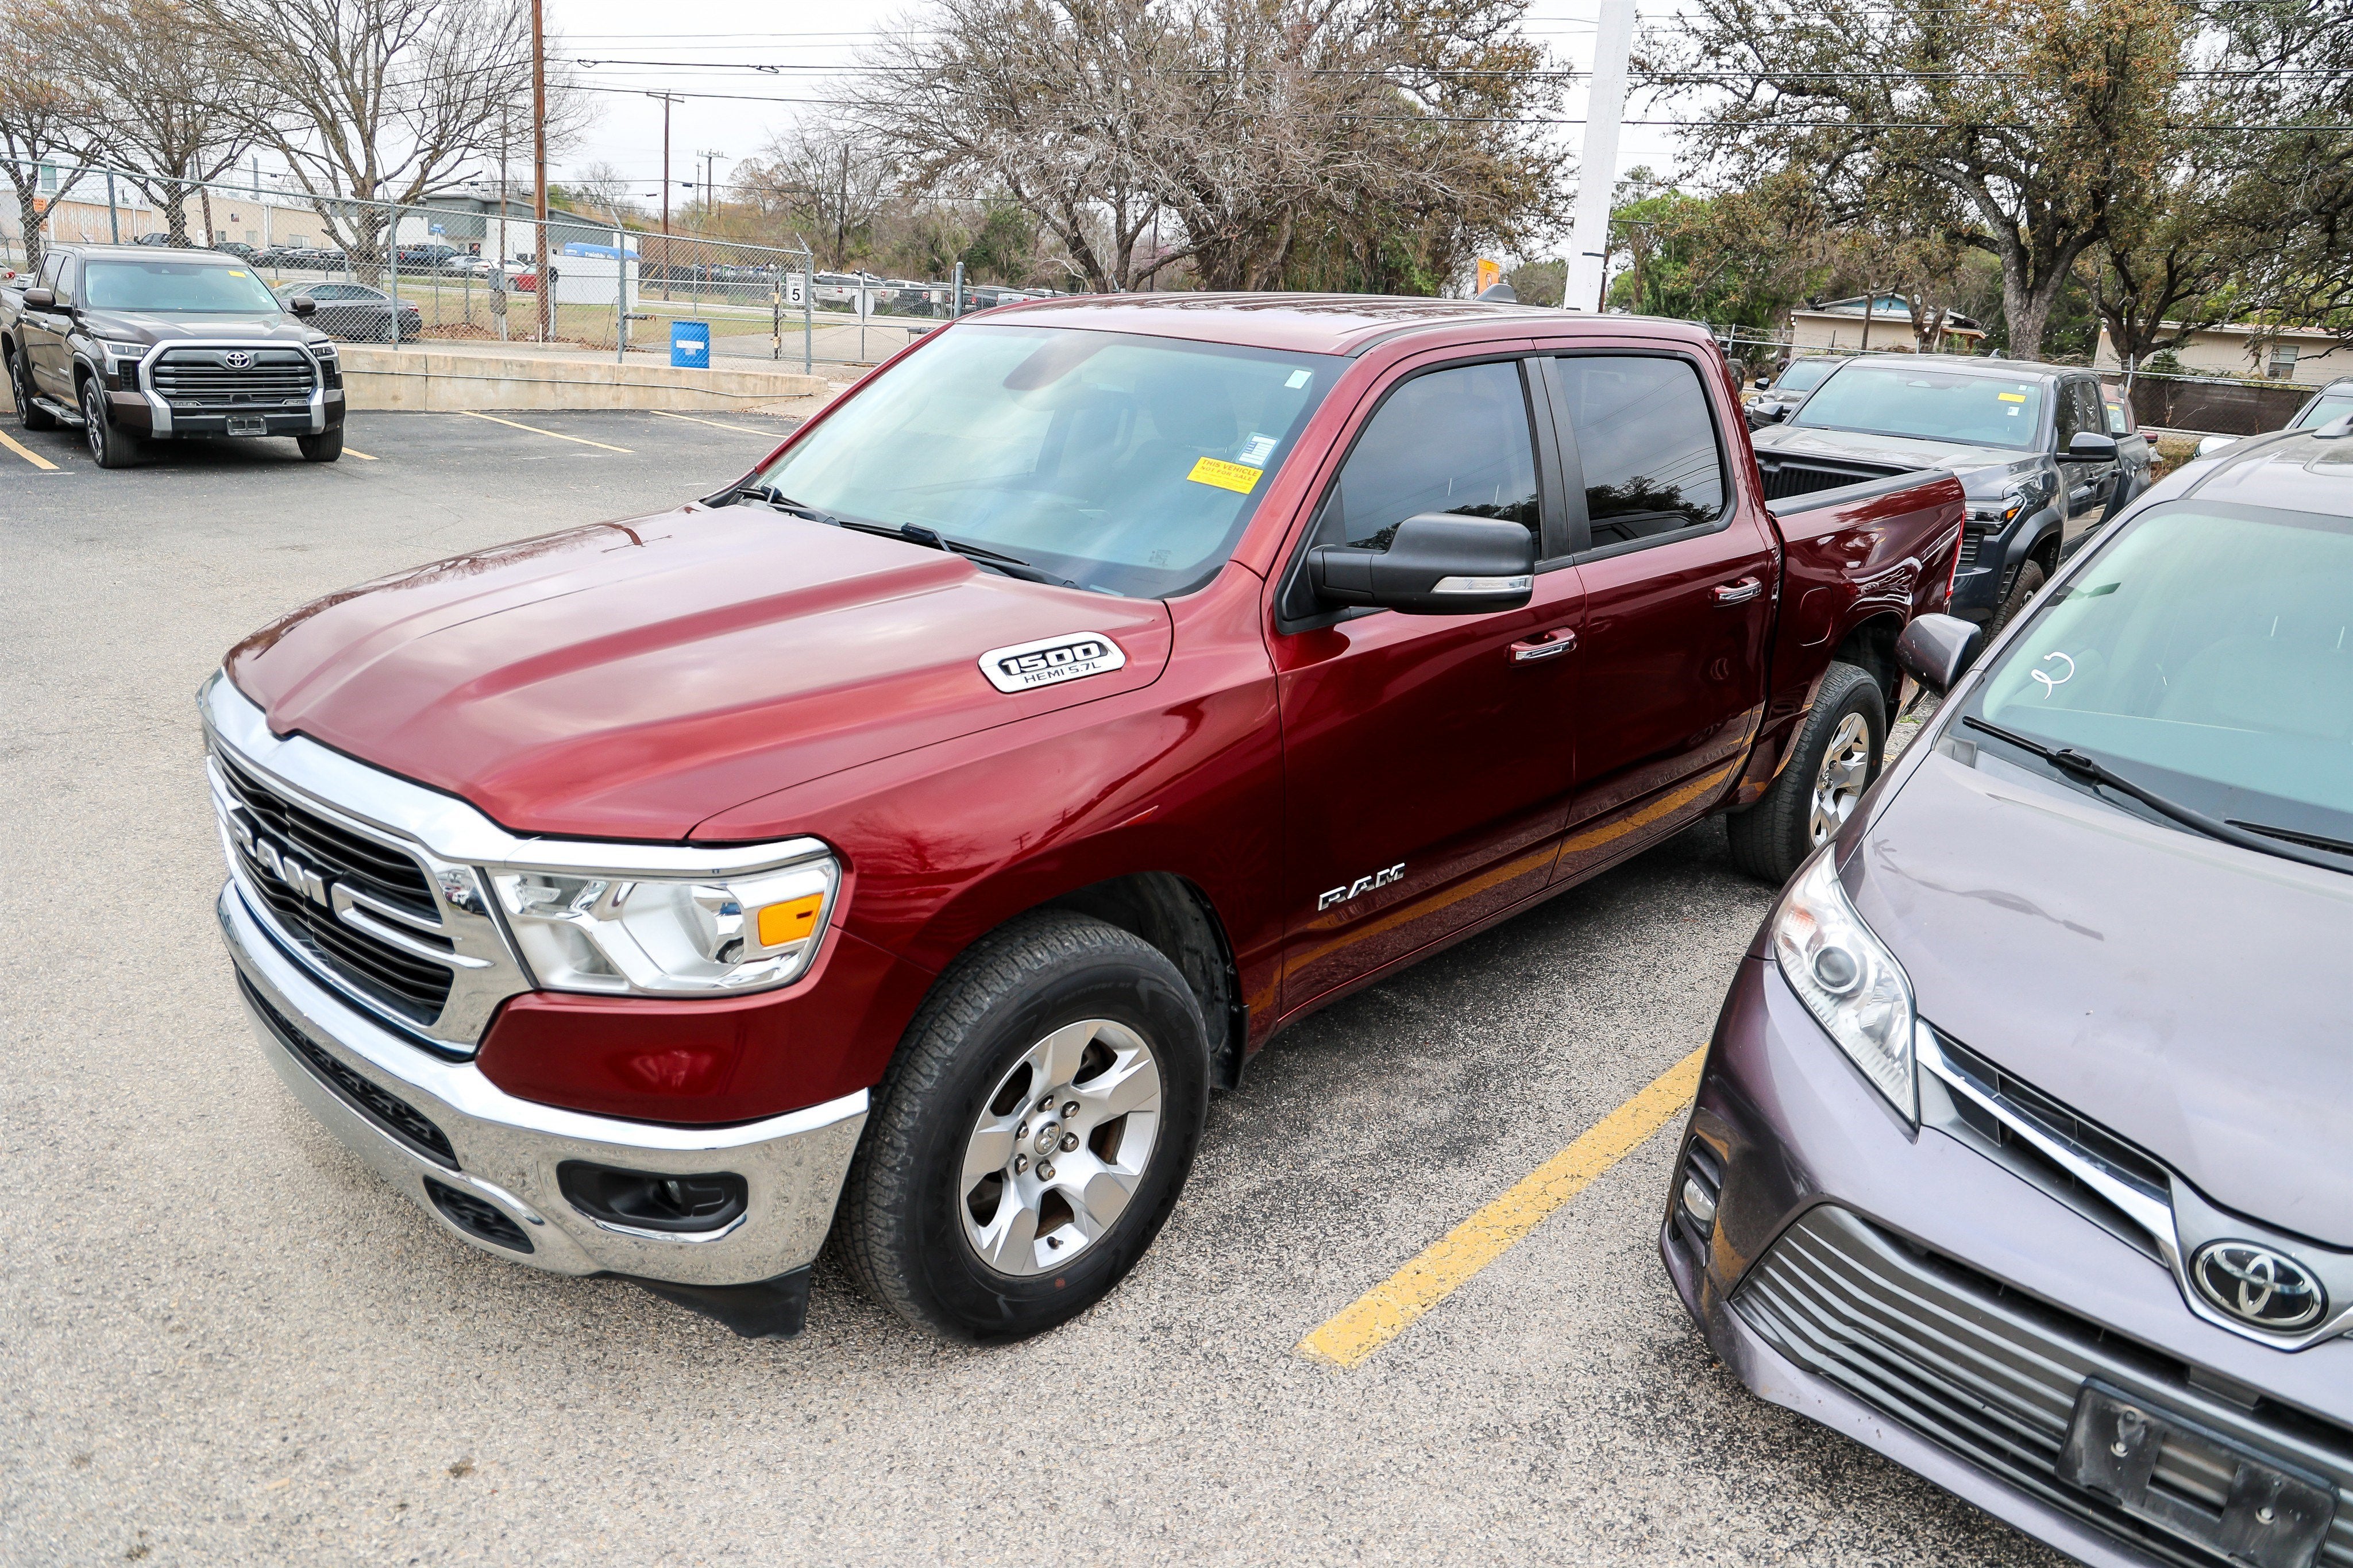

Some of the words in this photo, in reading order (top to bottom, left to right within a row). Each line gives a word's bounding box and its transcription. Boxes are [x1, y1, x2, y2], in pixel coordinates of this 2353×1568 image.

[792, 288, 800, 301] 5
[1202, 459, 1221, 468] THIS
[1223, 464, 1259, 477] VEHICLE
[1233, 473, 1253, 481] SALE
[1001, 643, 1101, 676] 1500
[1024, 668, 1066, 683] HEMI
[1069, 661, 1102, 674] 5.7L
[228, 809, 329, 908] RAM
[1318, 862, 1405, 912] RAM
